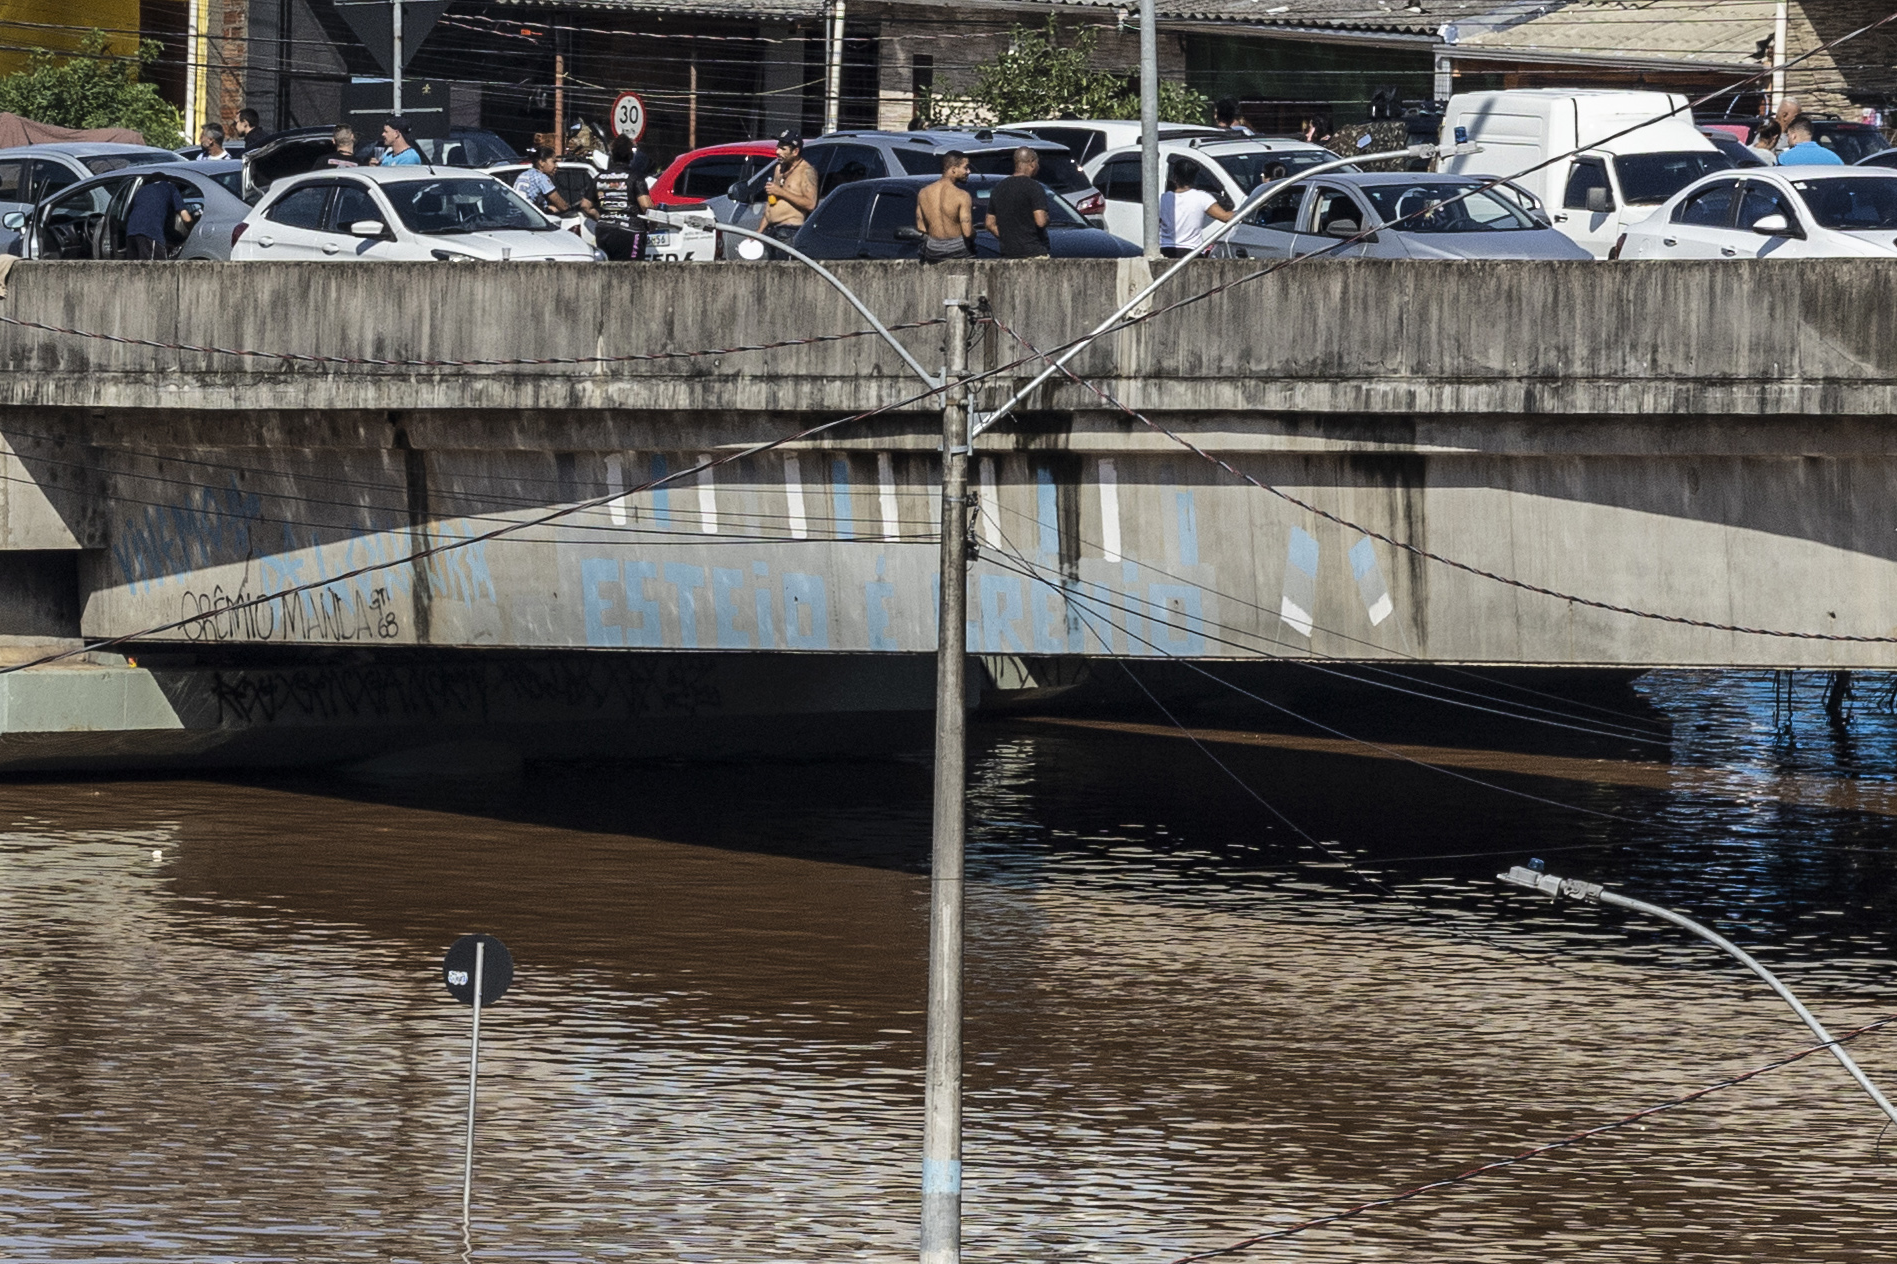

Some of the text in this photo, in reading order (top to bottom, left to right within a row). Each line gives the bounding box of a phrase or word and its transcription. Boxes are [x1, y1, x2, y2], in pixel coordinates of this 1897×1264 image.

[619, 105, 639, 124] 30
[282, 586, 374, 641] MANDA
[866, 554, 895, 648] É
[377, 611, 399, 639] 68
